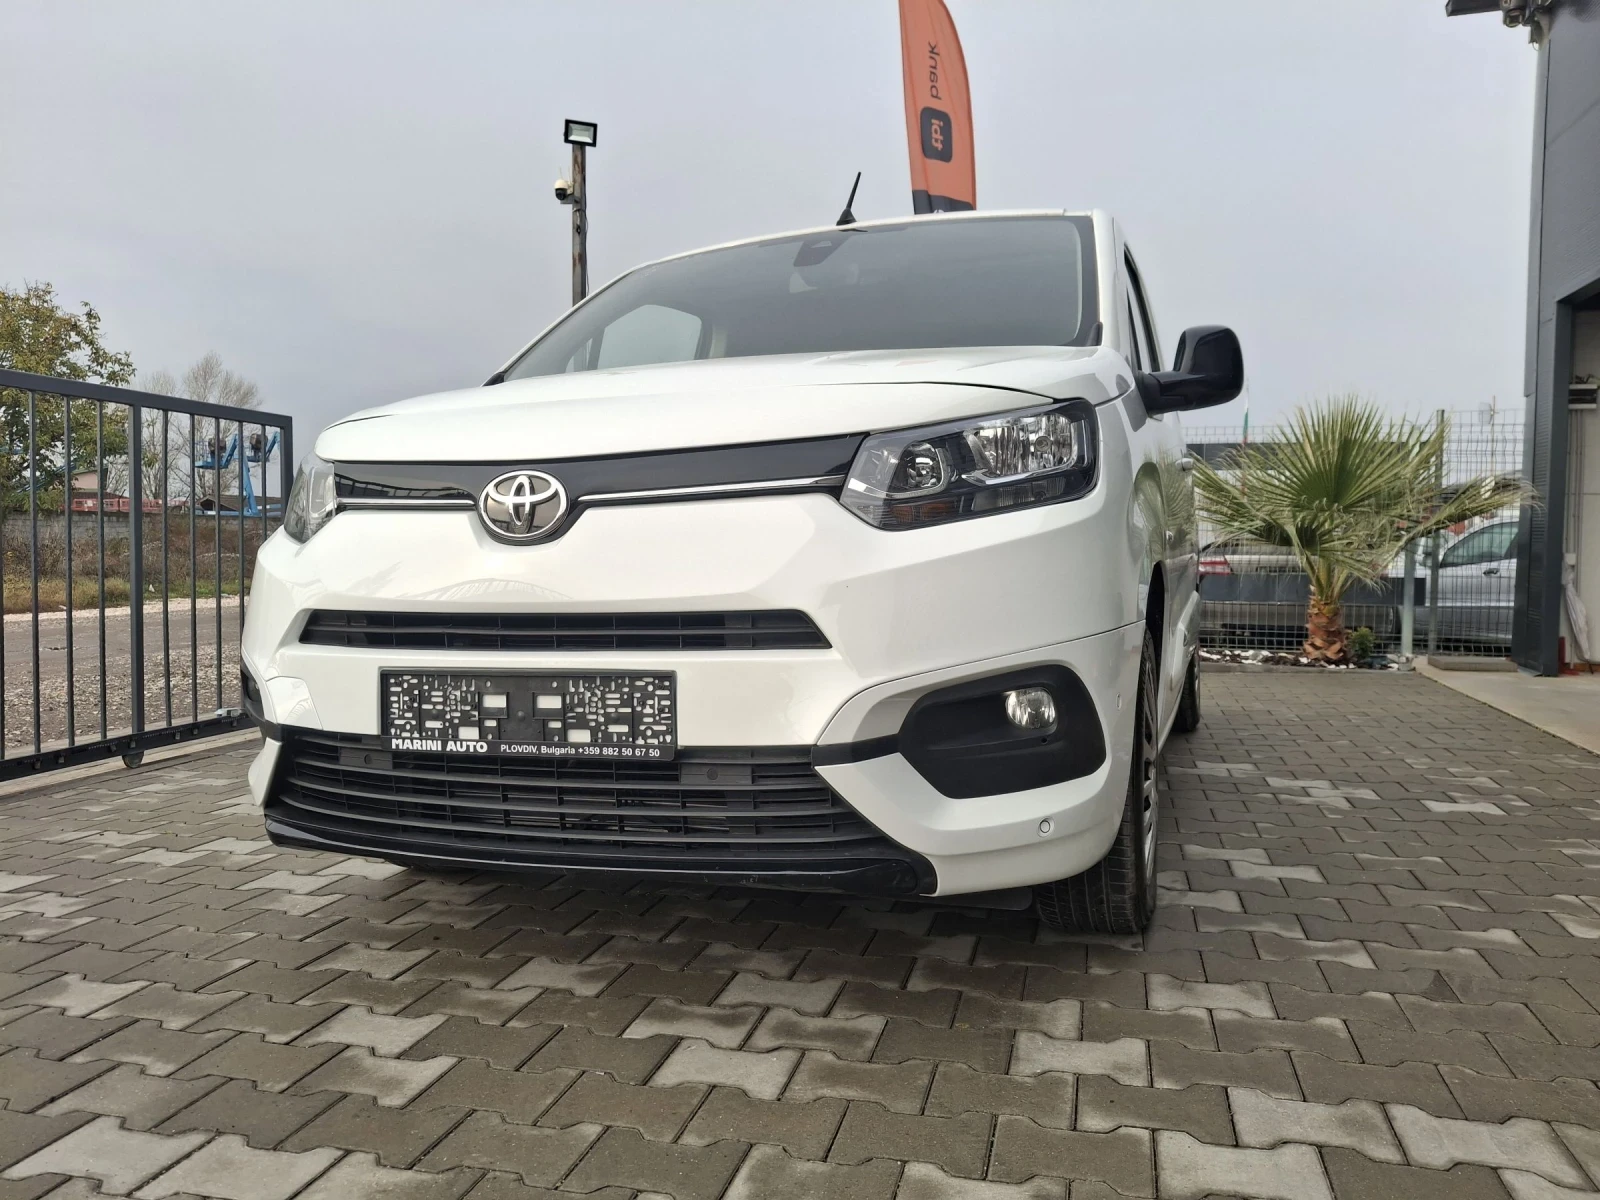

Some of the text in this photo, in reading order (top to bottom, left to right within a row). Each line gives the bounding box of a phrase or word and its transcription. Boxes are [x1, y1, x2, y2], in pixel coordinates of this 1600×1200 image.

[391, 738, 488, 753] MARINI AUTO
[500, 744, 660, 757] PLOVDIV, Bulgaria +359 882 50 67 50
